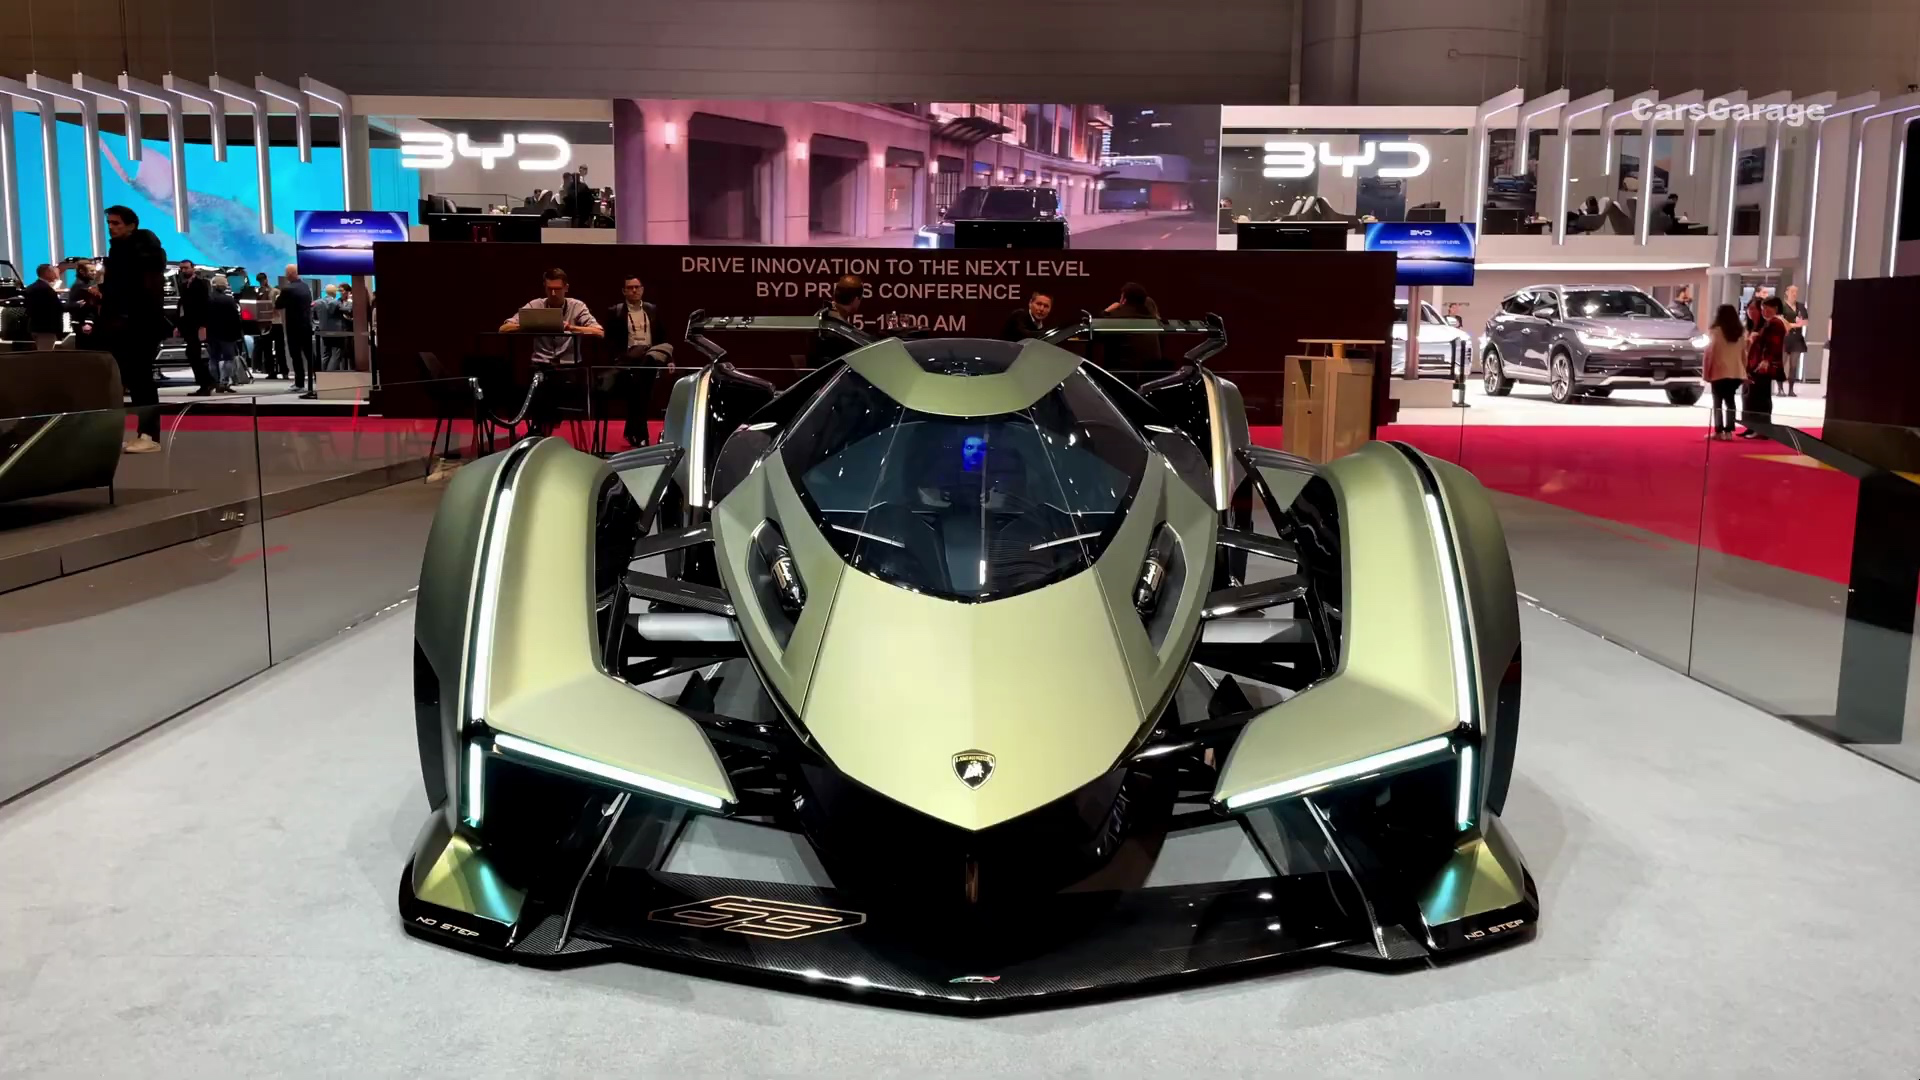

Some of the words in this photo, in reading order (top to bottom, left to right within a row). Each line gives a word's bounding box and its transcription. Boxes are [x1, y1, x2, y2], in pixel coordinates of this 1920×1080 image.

[401, 131, 572, 171] BYD
[1263, 141, 1430, 178] BYD
[681, 256, 745, 273] DRIVE
[751, 257, 880, 275] INNOVATION
[885, 259, 914, 275] TO
[919, 259, 960, 276] THE
[965, 260, 1021, 277] NEXT
[1026, 260, 1090, 277] LEVEL
[756, 281, 799, 297] BYD
[805, 283, 873, 299] PRS
[879, 283, 1021, 300] CONFERENCE
[933, 314, 966, 331] AM
[415, 916, 437, 926] NO
[440, 923, 480, 937] STEP
[1464, 930, 1486, 940] NO
[1488, 919, 1524, 934] STEP
